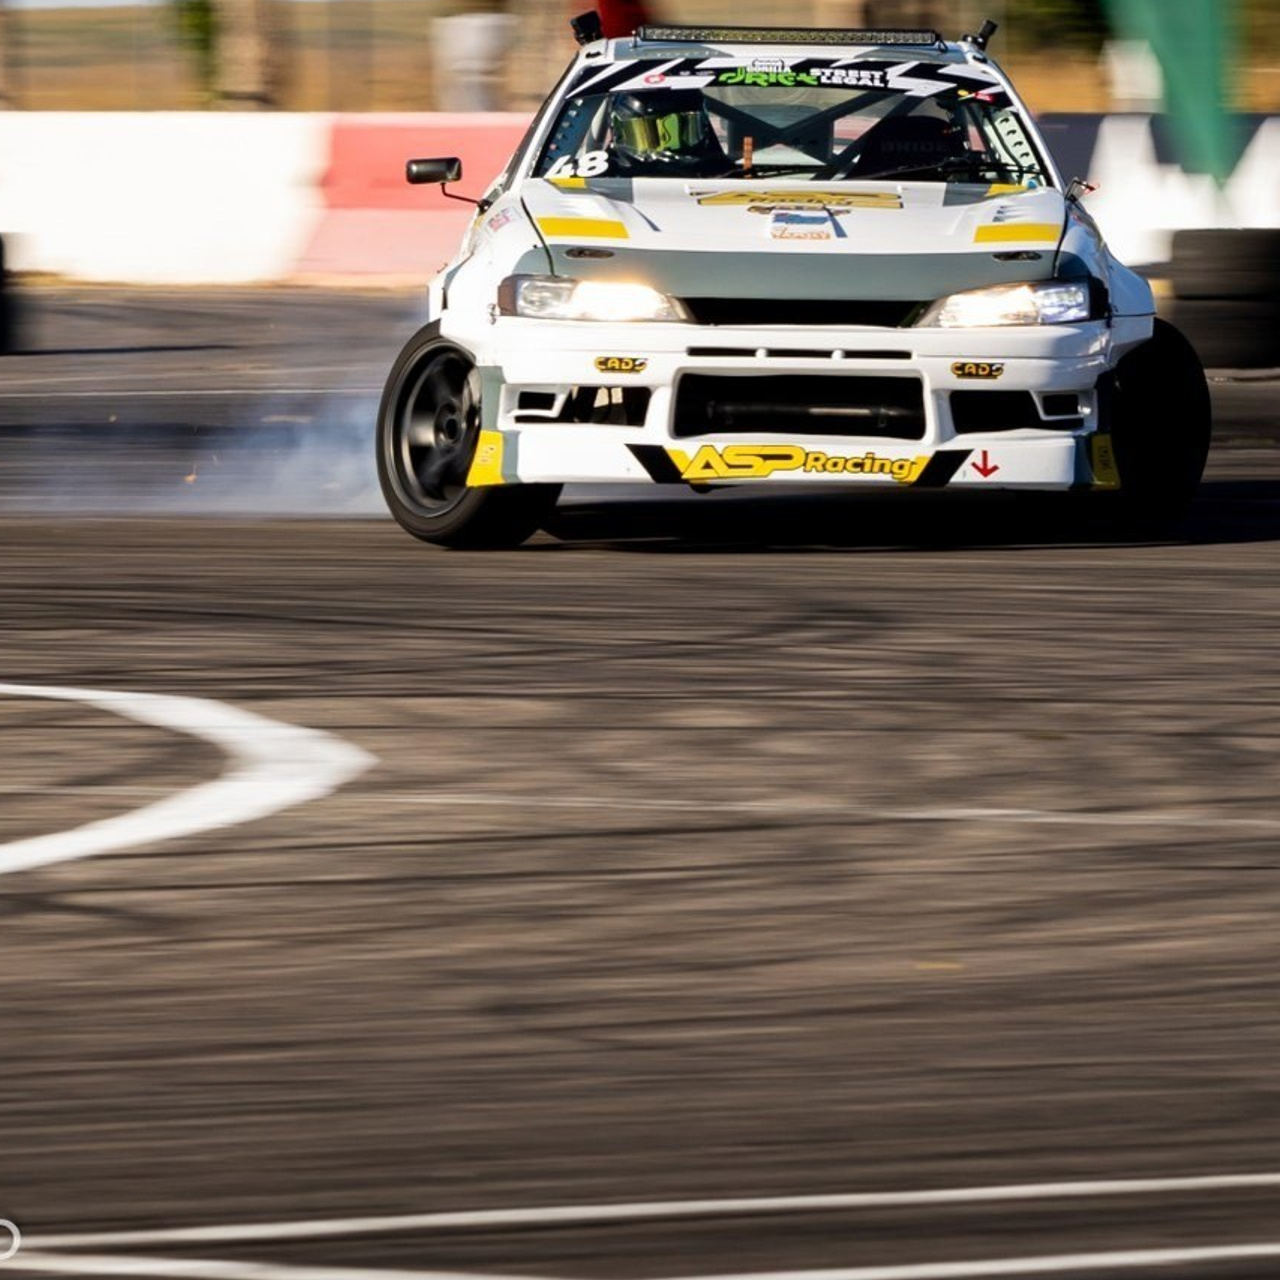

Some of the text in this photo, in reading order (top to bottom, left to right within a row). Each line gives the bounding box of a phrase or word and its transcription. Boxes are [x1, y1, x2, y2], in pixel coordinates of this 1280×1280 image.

[810, 67, 884, 79] STREET
[820, 76, 885, 87] LEGAL
[543, 150, 609, 179] 48
[594, 356, 648, 372] CADS
[951, 361, 1004, 378] CADS
[681, 444, 920, 483] ASP Racing
